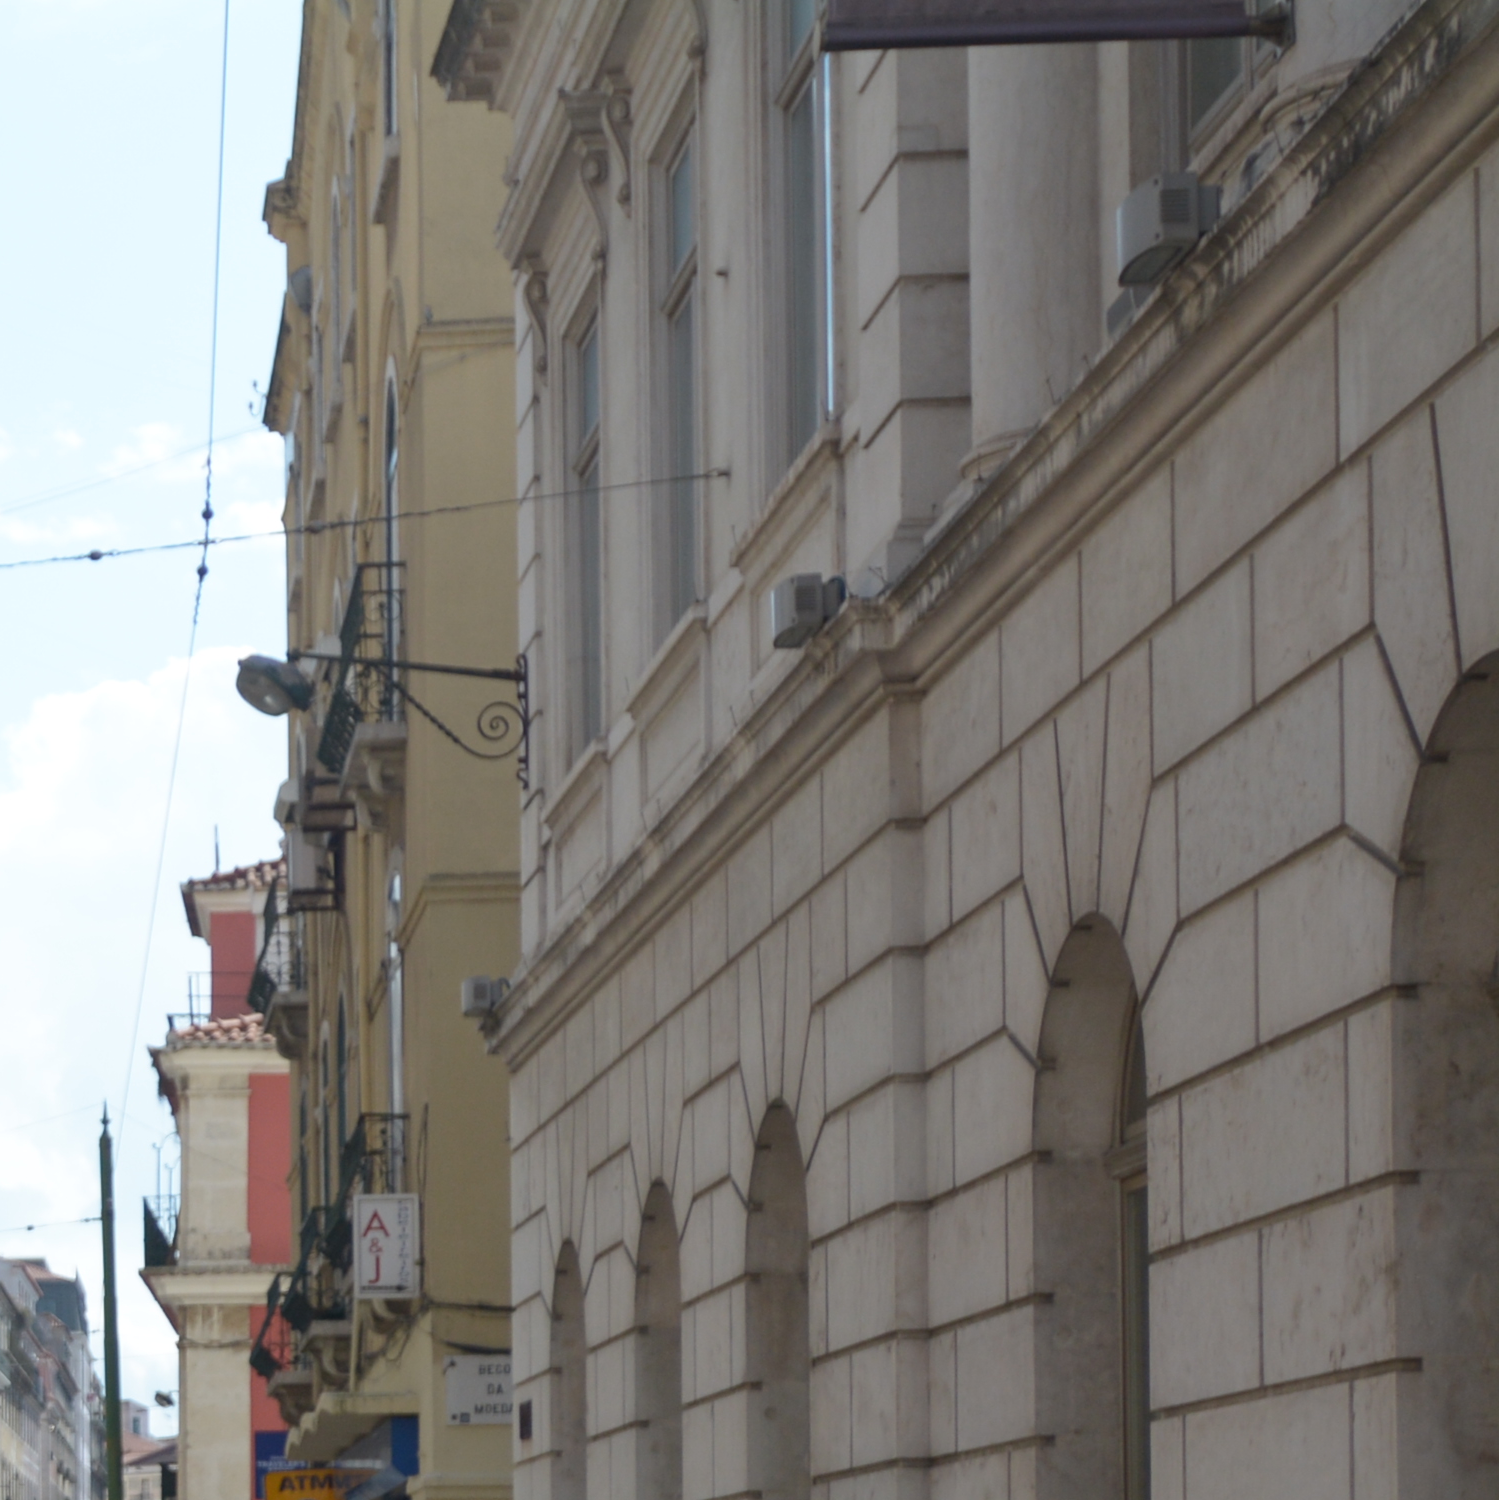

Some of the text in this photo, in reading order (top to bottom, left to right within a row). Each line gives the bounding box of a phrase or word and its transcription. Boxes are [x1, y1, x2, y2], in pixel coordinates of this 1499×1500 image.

[362, 1208, 391, 1238] A
[368, 1254, 380, 1285] J
[478, 1363, 512, 1376] BECO
[487, 1383, 505, 1395] DA
[279, 1473, 334, 1492] ATM
